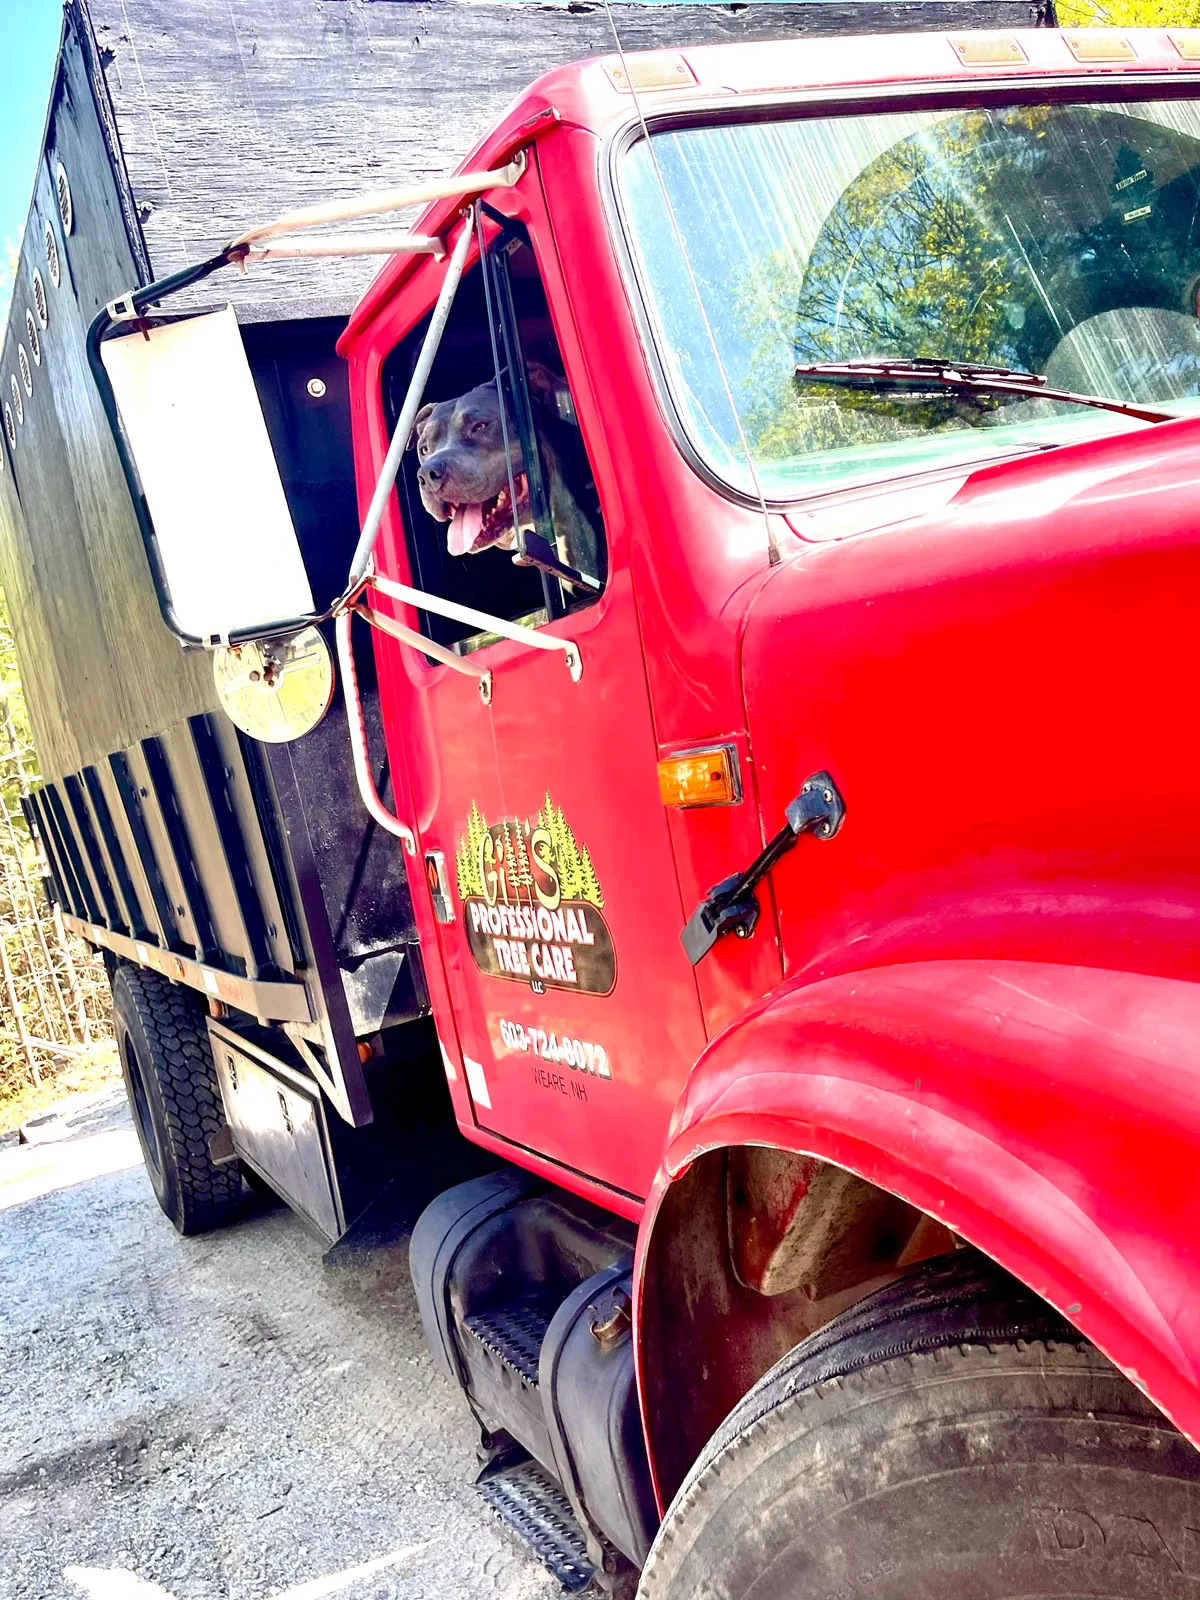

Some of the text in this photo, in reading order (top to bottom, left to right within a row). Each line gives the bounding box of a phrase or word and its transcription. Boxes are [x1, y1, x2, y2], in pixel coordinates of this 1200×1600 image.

[469, 902, 595, 945] PROFESSIONAL
[493, 937, 577, 983] TREE CARE
[531, 980, 544, 994] LLC
[499, 1018, 612, 1080] 603-724-8072
[531, 1067, 588, 1102] WEARE, NH
